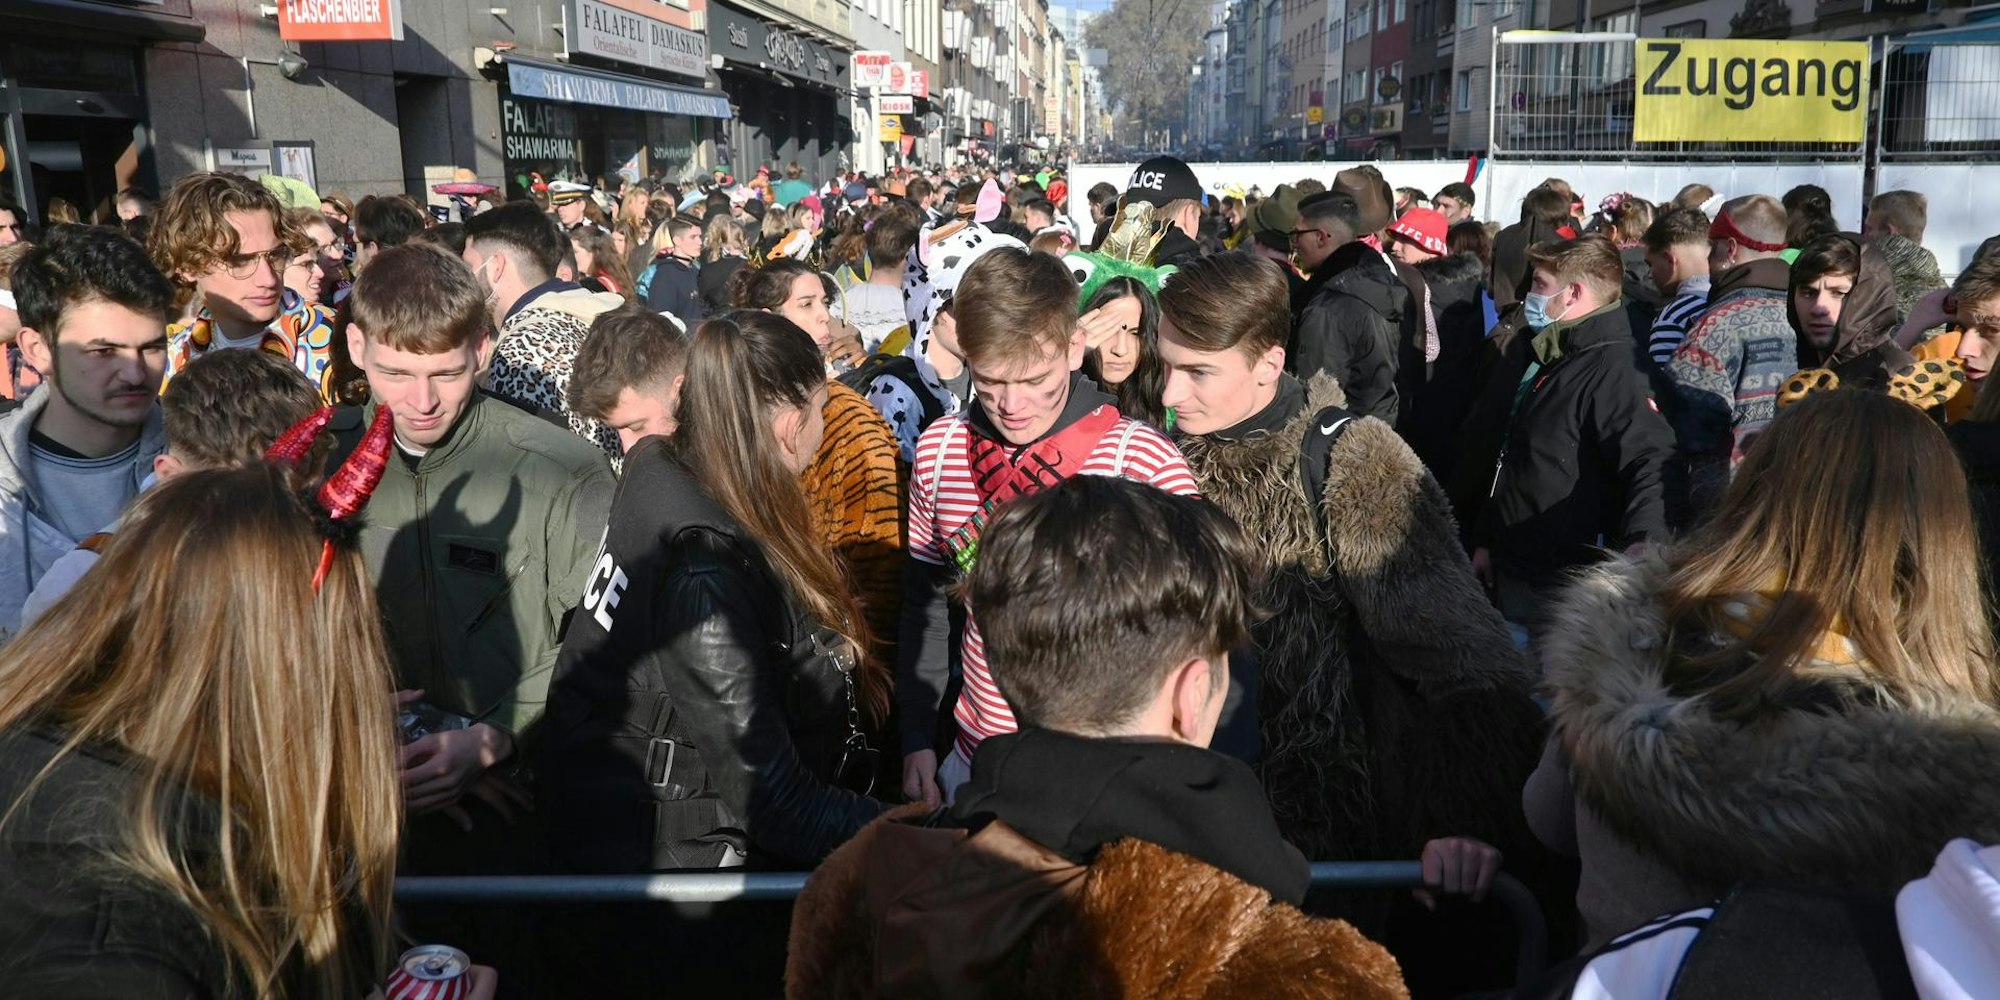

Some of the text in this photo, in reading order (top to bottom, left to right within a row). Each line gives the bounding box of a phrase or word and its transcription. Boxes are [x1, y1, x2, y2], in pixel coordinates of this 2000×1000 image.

[286, 0, 381, 24] FLASCHENBIER
[583, 4, 703, 57] FALAFEL DAMASKUS
[593, 35, 638, 59] Orientalische
[1642, 43, 1861, 111] Zugang
[543, 72, 619, 105] SHAWARMA
[674, 95, 717, 117] DAMASKUS
[882, 102, 911, 111] KIOSK
[506, 135, 575, 160] SHAWARMA
